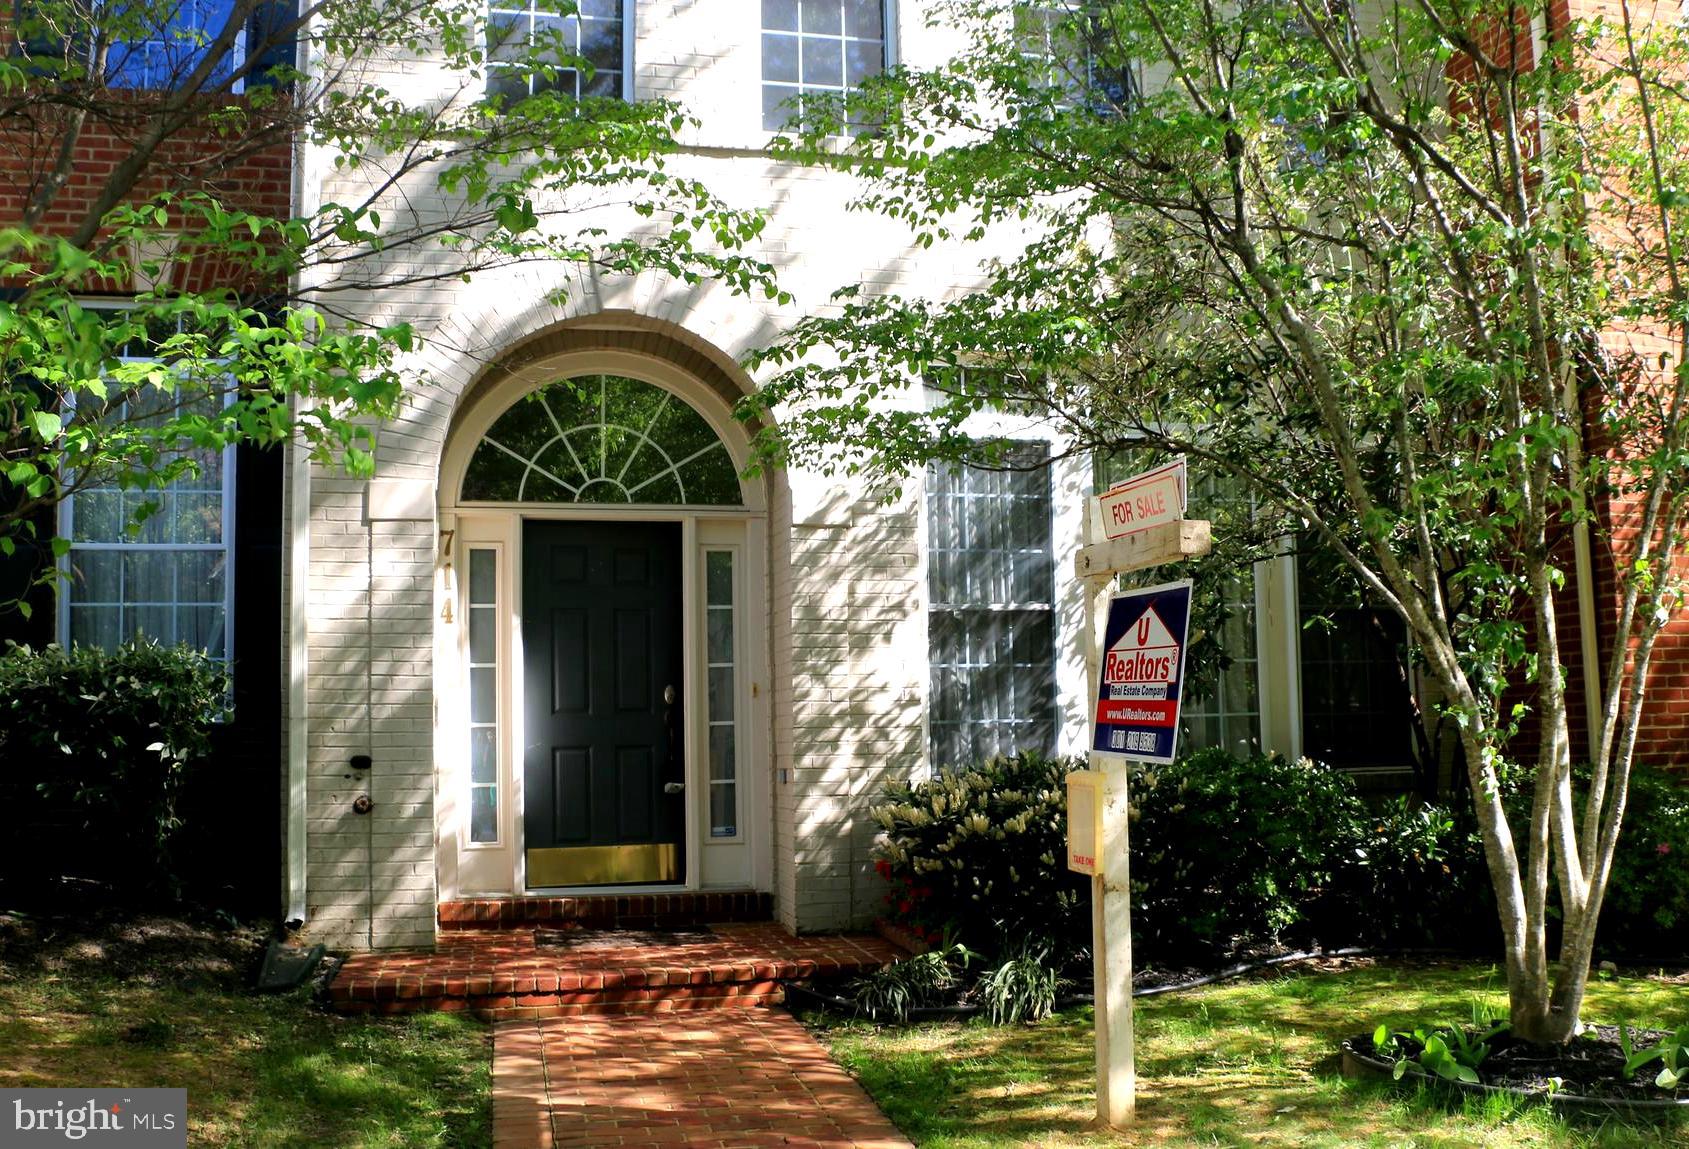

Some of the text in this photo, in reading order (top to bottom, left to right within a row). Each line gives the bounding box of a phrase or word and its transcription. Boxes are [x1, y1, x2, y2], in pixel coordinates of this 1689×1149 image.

[1112, 490, 1166, 526] FOR SALE
[440, 529, 454, 624] 714
[1137, 616, 1150, 647] U
[1110, 685, 1167, 698] Real Estate Company
[1106, 707, 1166, 721] www.URealtors.com
